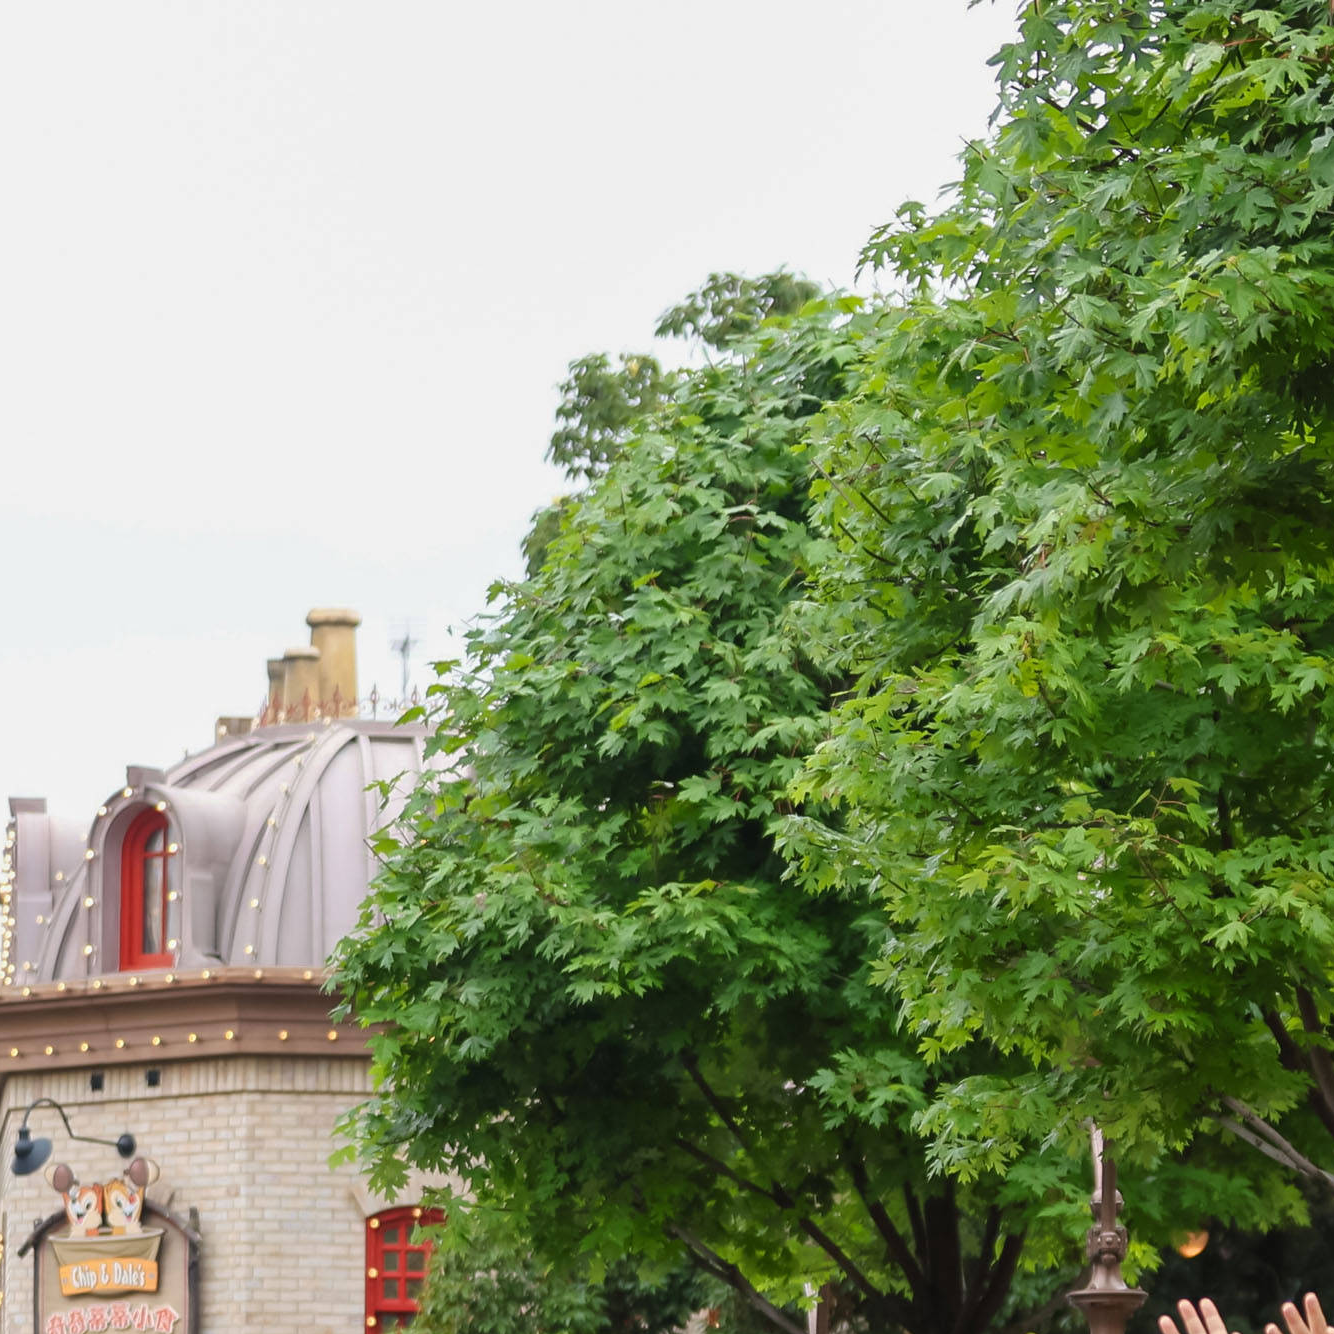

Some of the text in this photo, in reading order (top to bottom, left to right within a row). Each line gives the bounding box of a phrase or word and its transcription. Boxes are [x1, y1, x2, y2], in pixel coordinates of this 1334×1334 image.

[72, 1262, 145, 1289] Chip & Dale's
